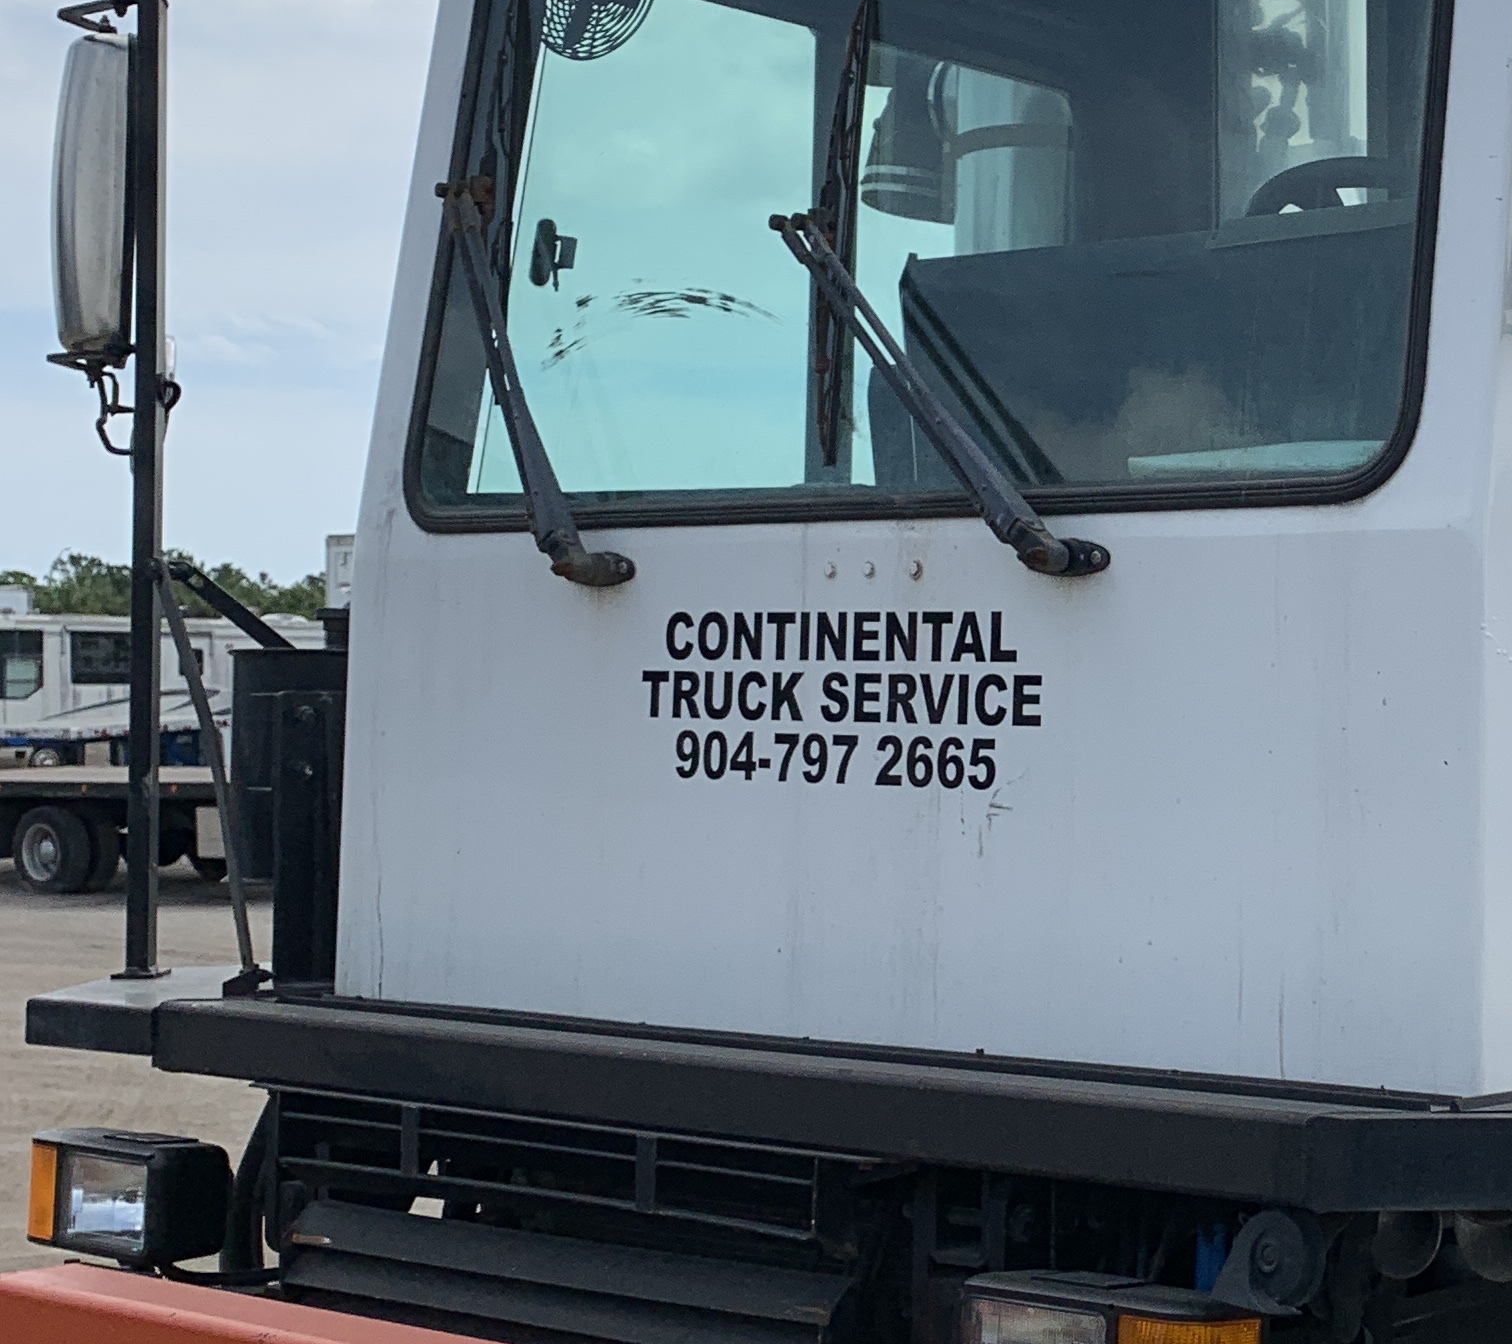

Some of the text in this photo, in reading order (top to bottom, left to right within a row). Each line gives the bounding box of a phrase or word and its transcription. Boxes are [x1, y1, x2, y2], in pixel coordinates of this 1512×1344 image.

[666, 611, 1018, 663] CONTINENTAL
[642, 670, 1043, 727] TRUCK SERVICE
[675, 730, 997, 791] 904-797 2665
